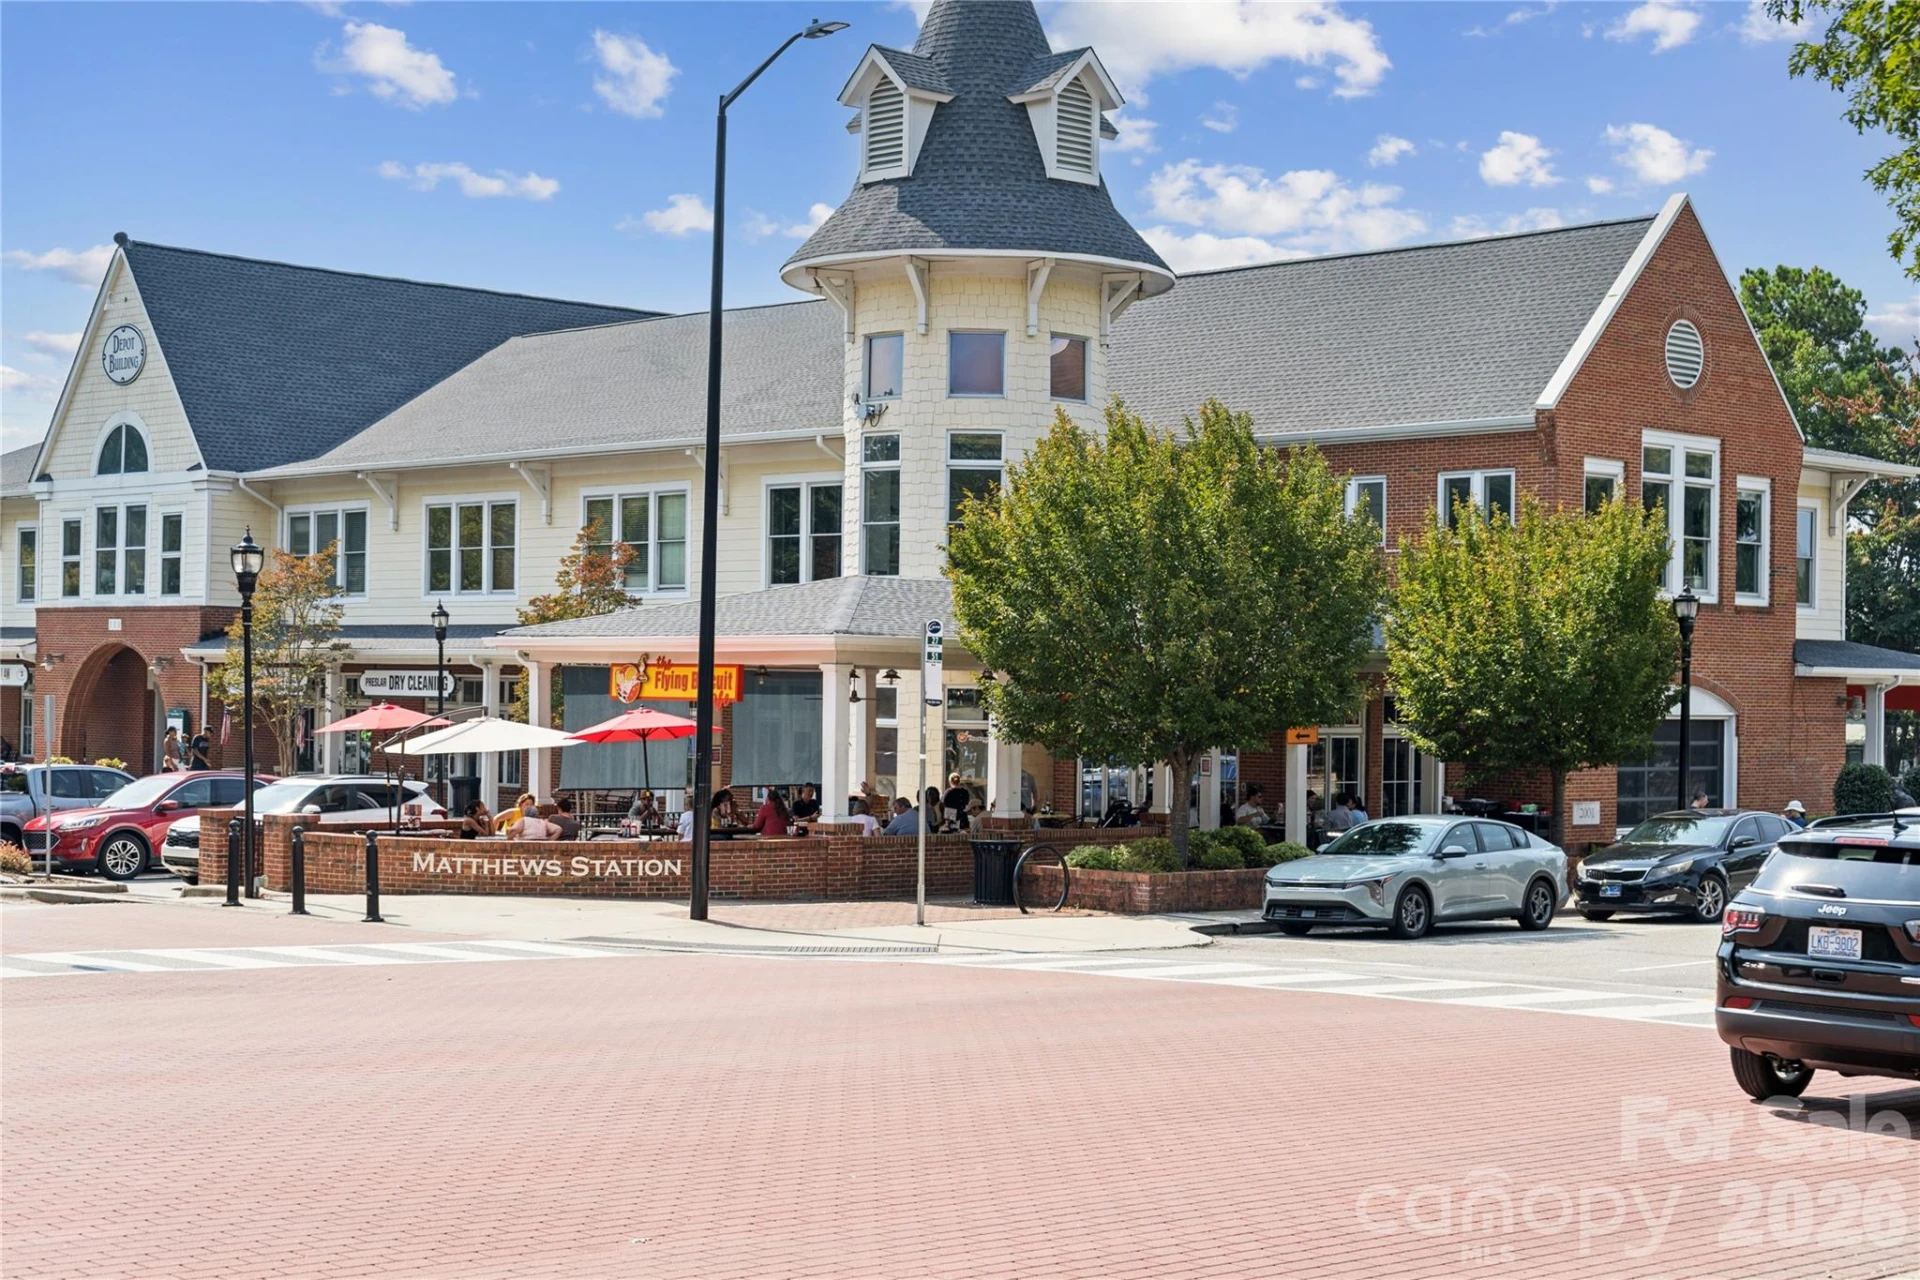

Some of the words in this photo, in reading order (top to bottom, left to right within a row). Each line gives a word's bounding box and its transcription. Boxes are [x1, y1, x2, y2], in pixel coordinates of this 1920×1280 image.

[113, 335, 135, 354] DEPOT
[109, 354, 139, 373] BUILDING
[931, 636, 939, 645] 27
[656, 655, 673, 670] the
[931, 652, 939, 660] 51
[365, 677, 387, 687] PRESLAR
[388, 675, 405, 690] DRY
[408, 675, 448, 691] CLEANIG
[655, 671, 689, 691] Flying
[691, 671, 733, 690] Buit
[1579, 807, 1595, 819] 2001
[412, 852, 562, 876] MATTHEWS
[570, 856, 681, 876] STATION
[1817, 904, 1847, 916] Jeep
